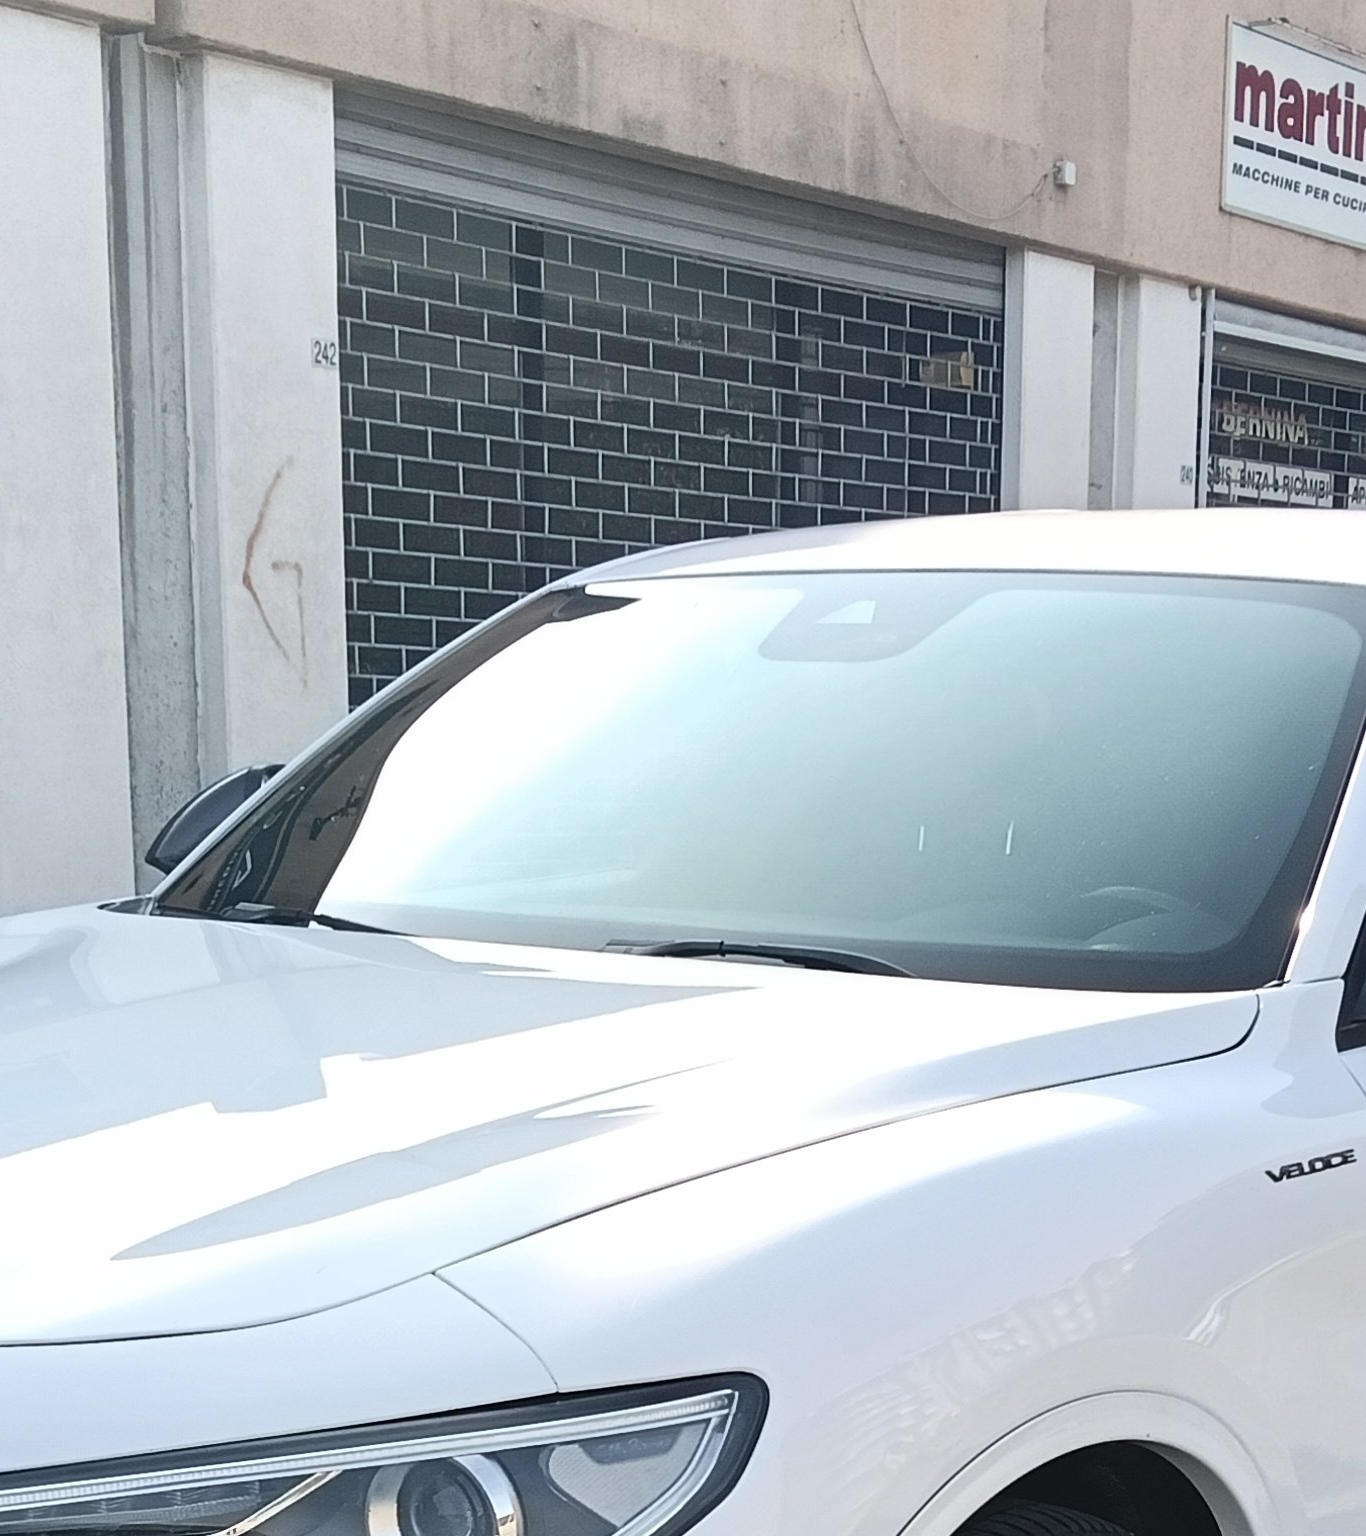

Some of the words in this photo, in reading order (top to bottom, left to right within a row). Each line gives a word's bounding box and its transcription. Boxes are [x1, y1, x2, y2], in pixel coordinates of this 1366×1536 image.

[1232, 162, 1300, 193] MACCHINE
[1305, 185, 1329, 201] PER
[314, 340, 337, 366] 242
[1282, 475, 1329, 500] RICAMBI
[1264, 1148, 1357, 1183] VELOCE
